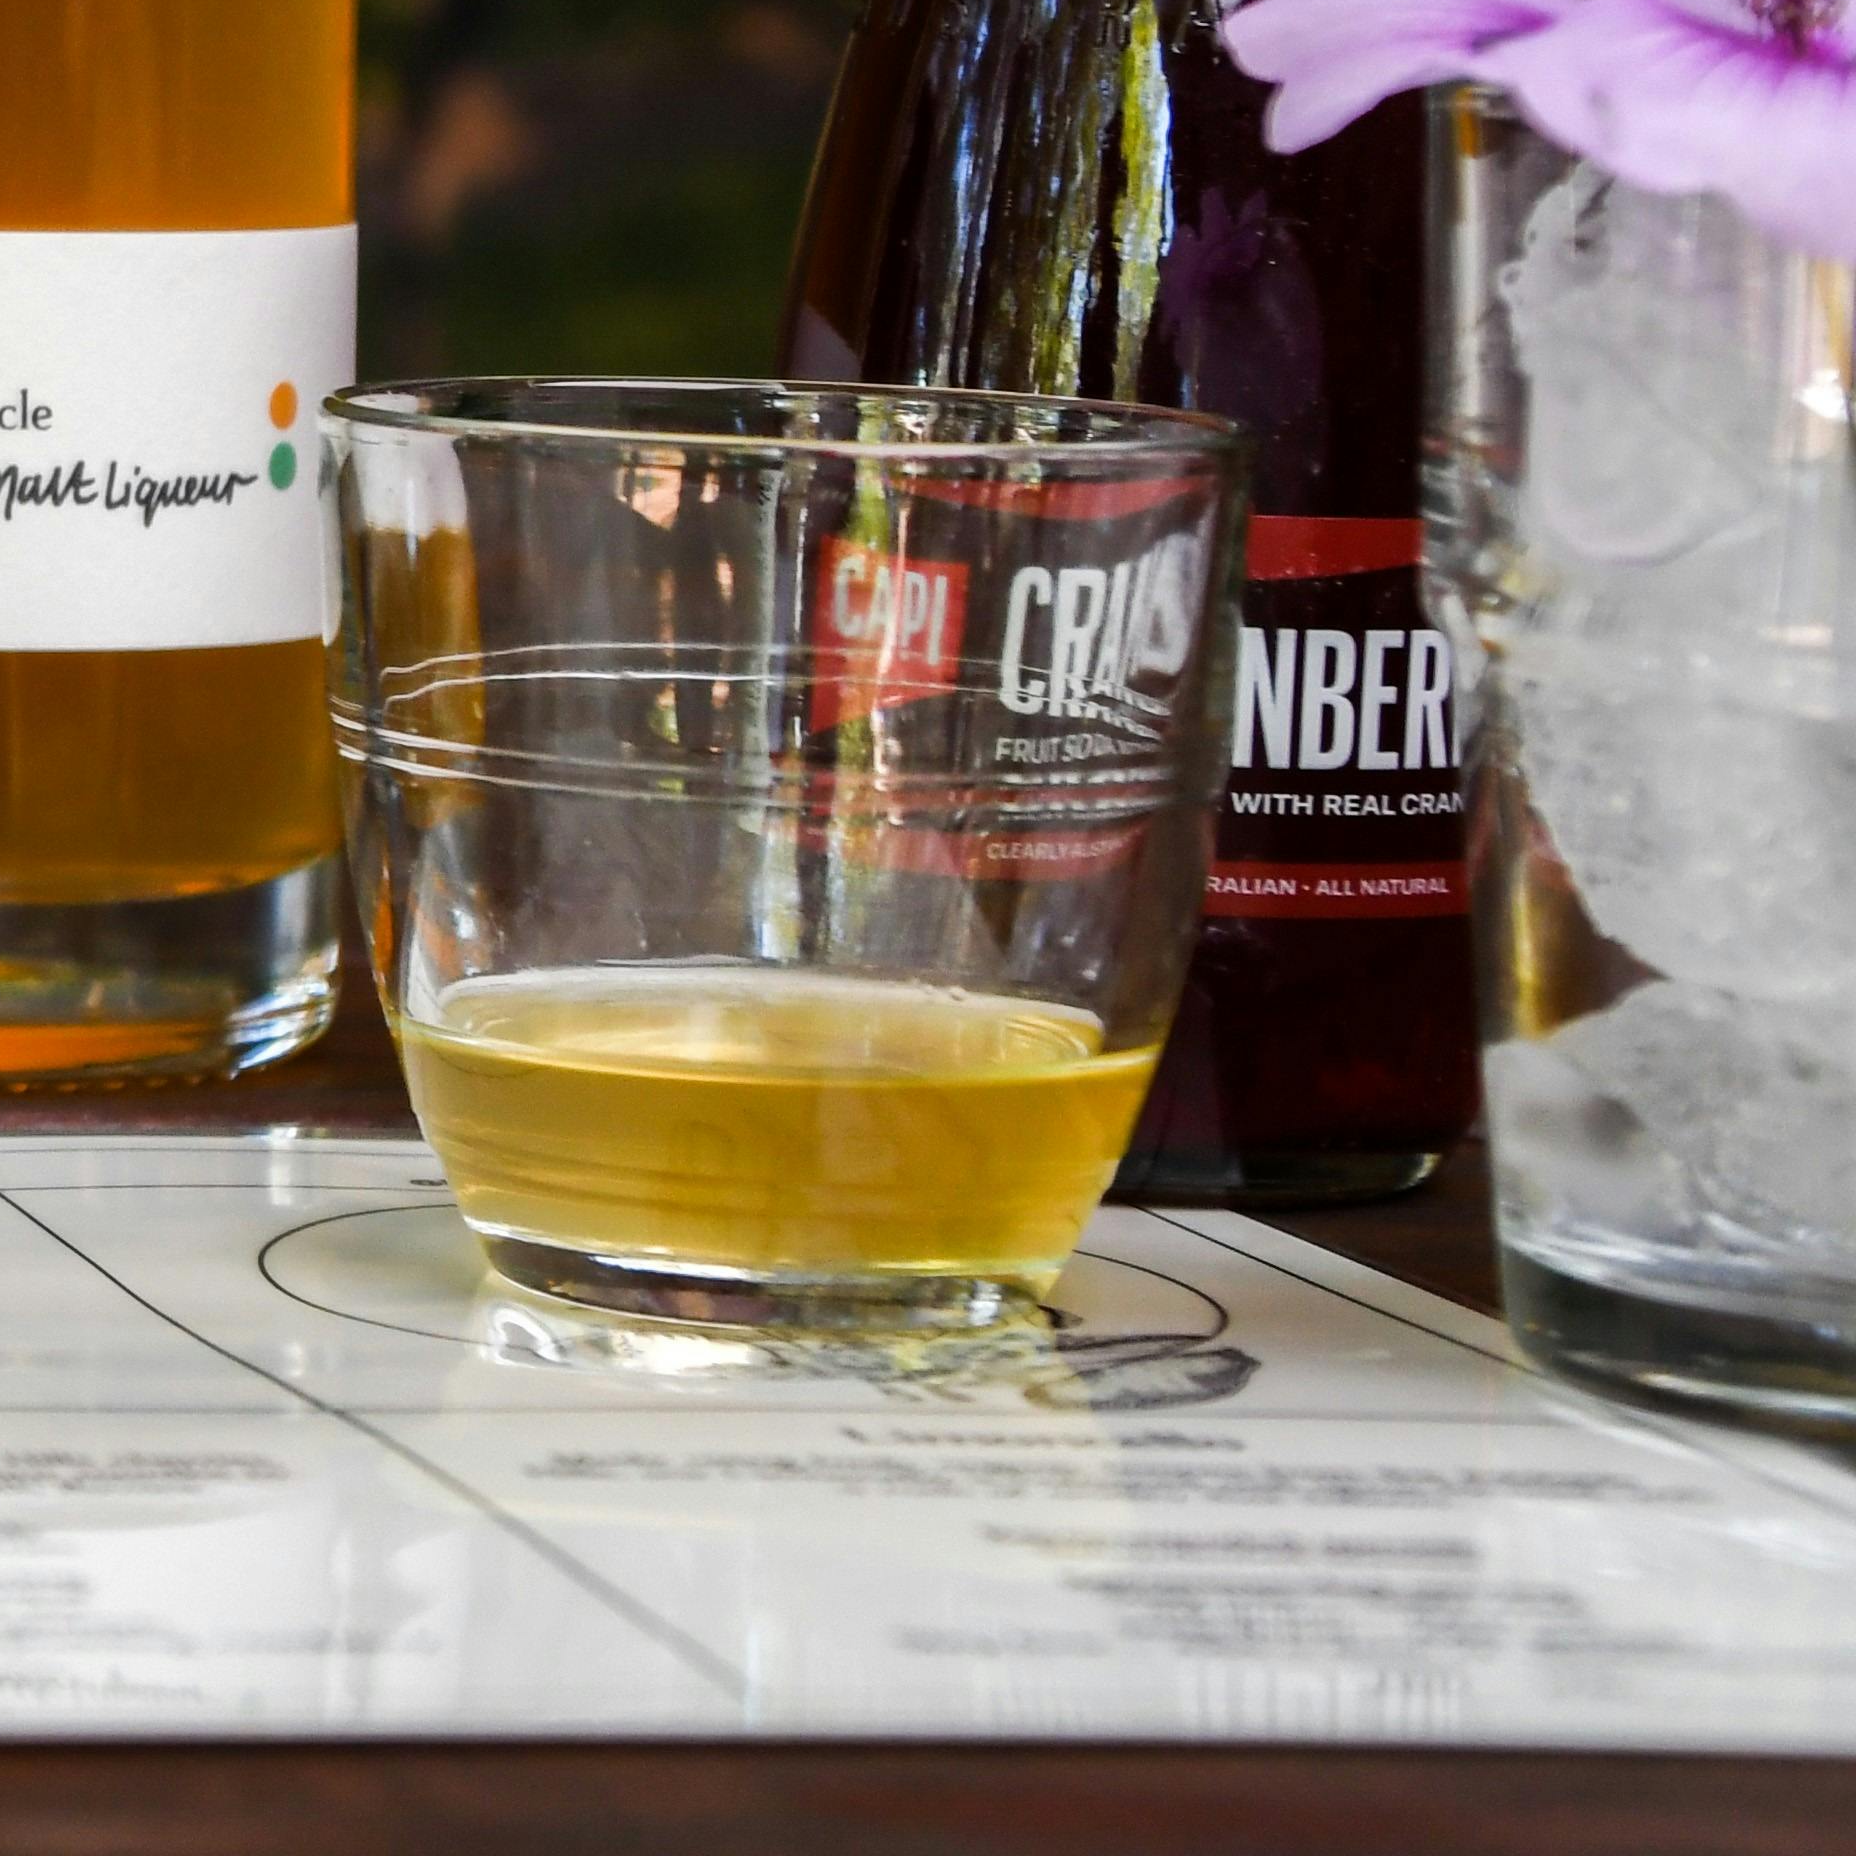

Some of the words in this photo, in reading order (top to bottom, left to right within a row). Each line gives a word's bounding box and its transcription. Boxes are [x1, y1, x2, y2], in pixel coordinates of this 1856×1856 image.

[105, 459, 258, 528] Liqueur
[831, 553, 948, 667] CAPI
[1232, 626, 1461, 771] NBER
[1231, 792, 1313, 816] WITH
[1323, 794, 1395, 817] REAL
[1401, 792, 1465, 816] CRAN
[1206, 876, 1296, 896] RALIAN
[1314, 879, 1356, 897] ALL
[1359, 878, 1450, 897] NATURAL
